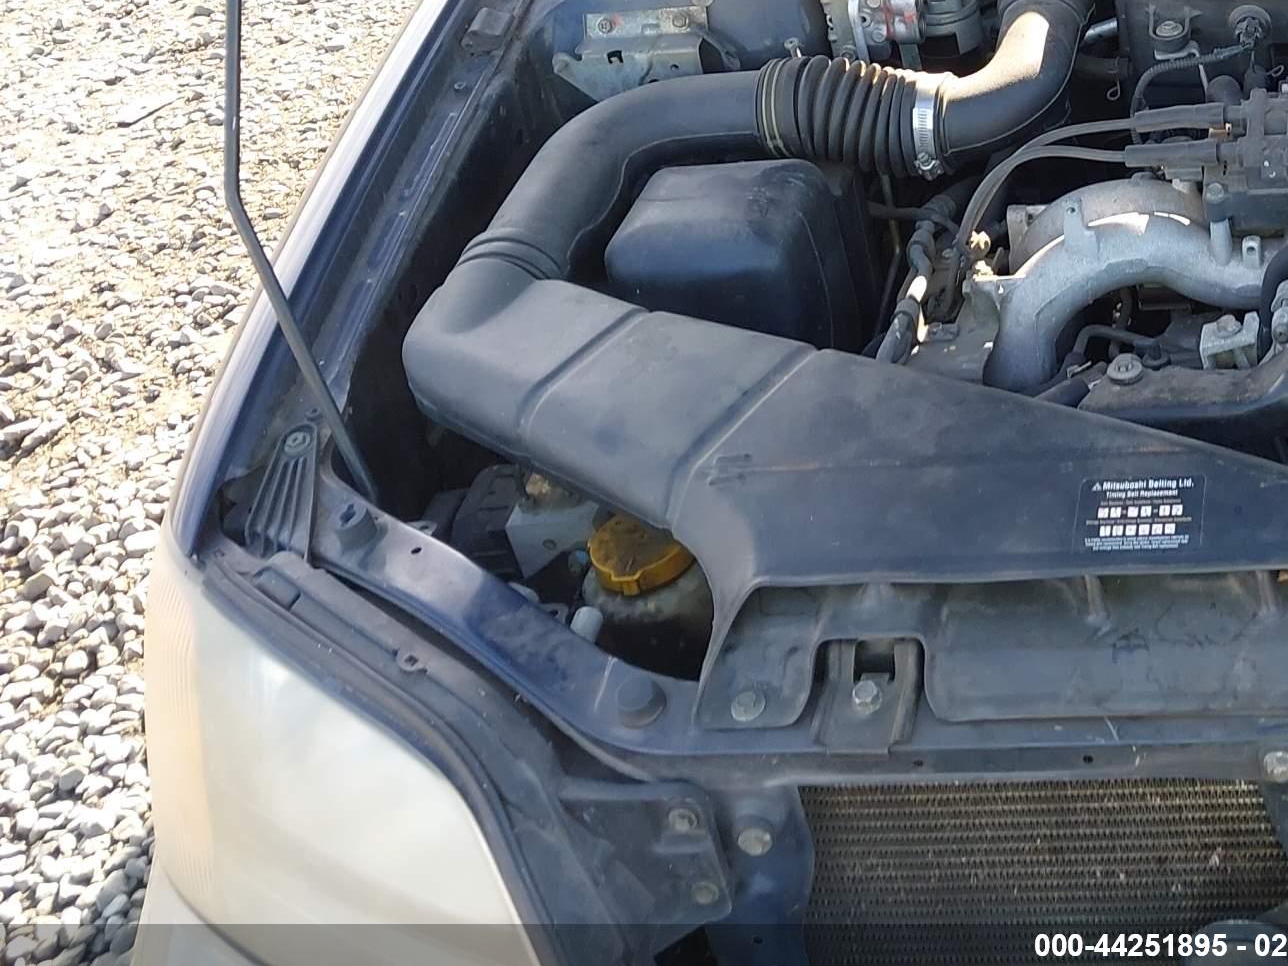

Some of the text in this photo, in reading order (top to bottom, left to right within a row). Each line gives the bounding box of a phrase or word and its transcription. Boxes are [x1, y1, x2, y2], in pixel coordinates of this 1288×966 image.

[1103, 478, 1194, 491] Mitsuboshi Belting Ltd.
[1106, 491, 1126, 499] Timing
[1140, 489, 1178, 498] Replacement
